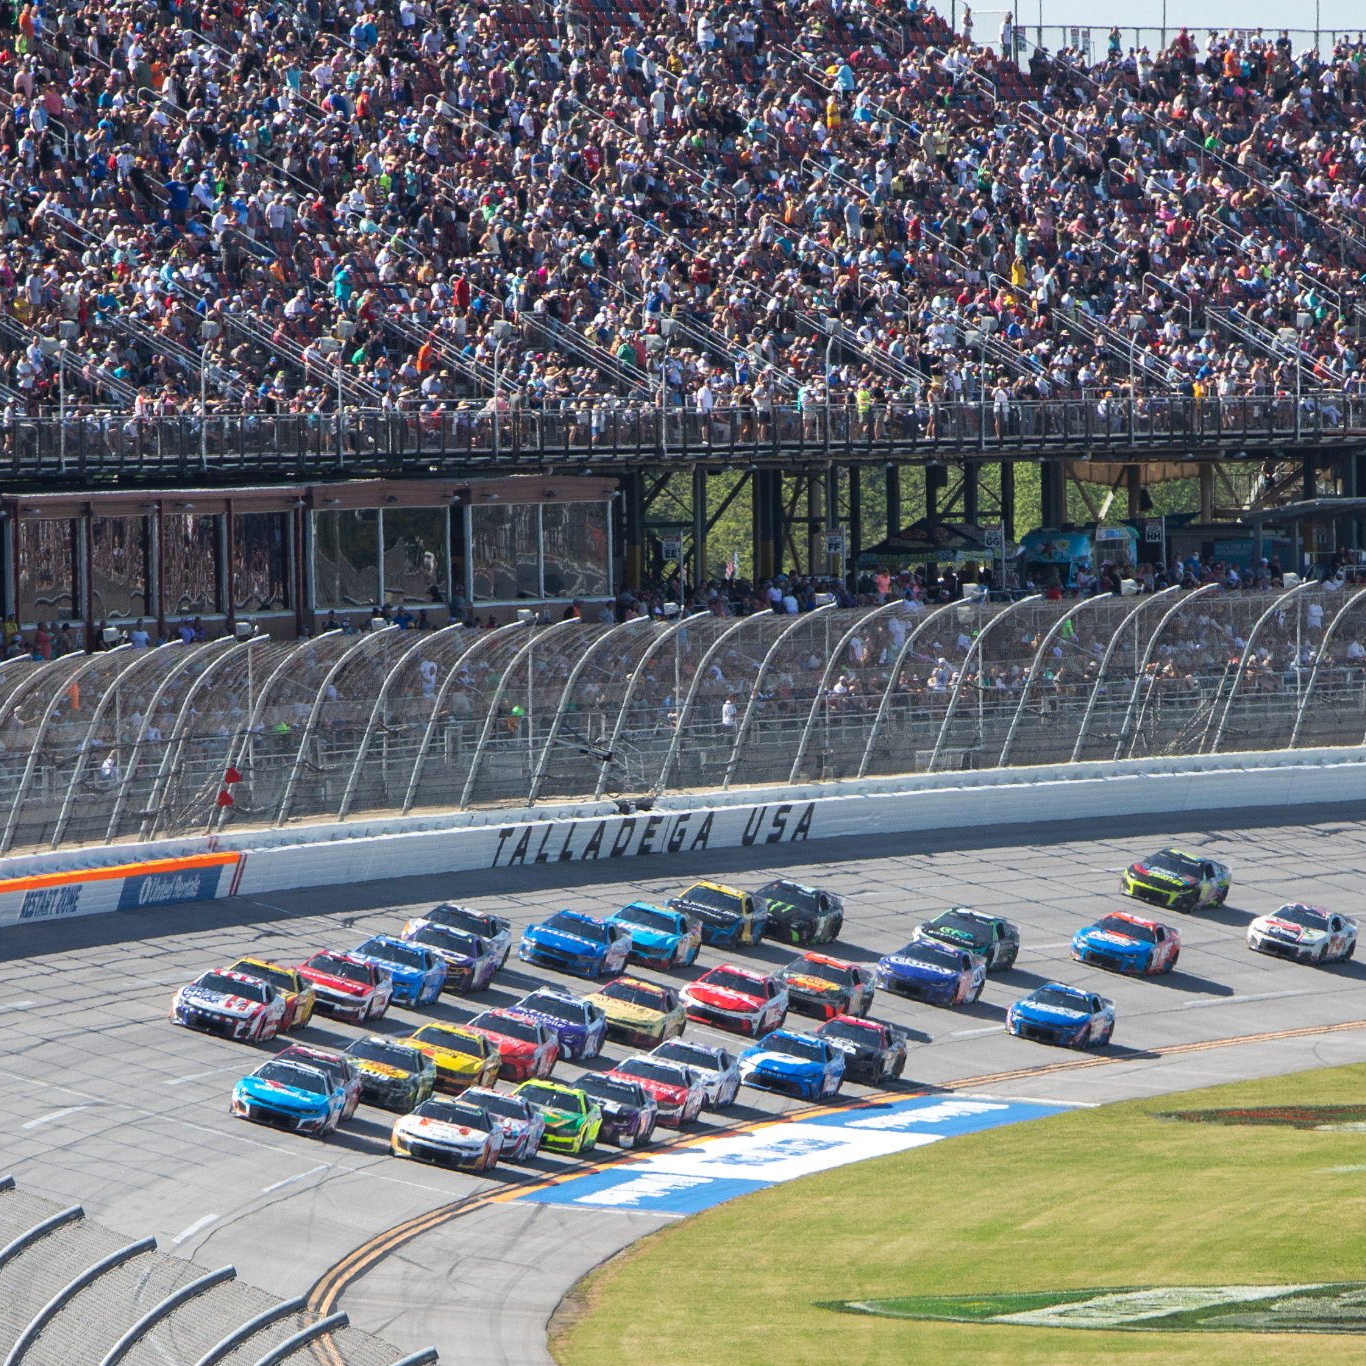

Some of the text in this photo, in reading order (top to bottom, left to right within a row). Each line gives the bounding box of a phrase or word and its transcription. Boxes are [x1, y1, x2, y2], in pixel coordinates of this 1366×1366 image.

[492, 802, 816, 868] TALLADEGA USA
[55, 884, 84, 914] ZONE
[150, 877, 174, 902] United
